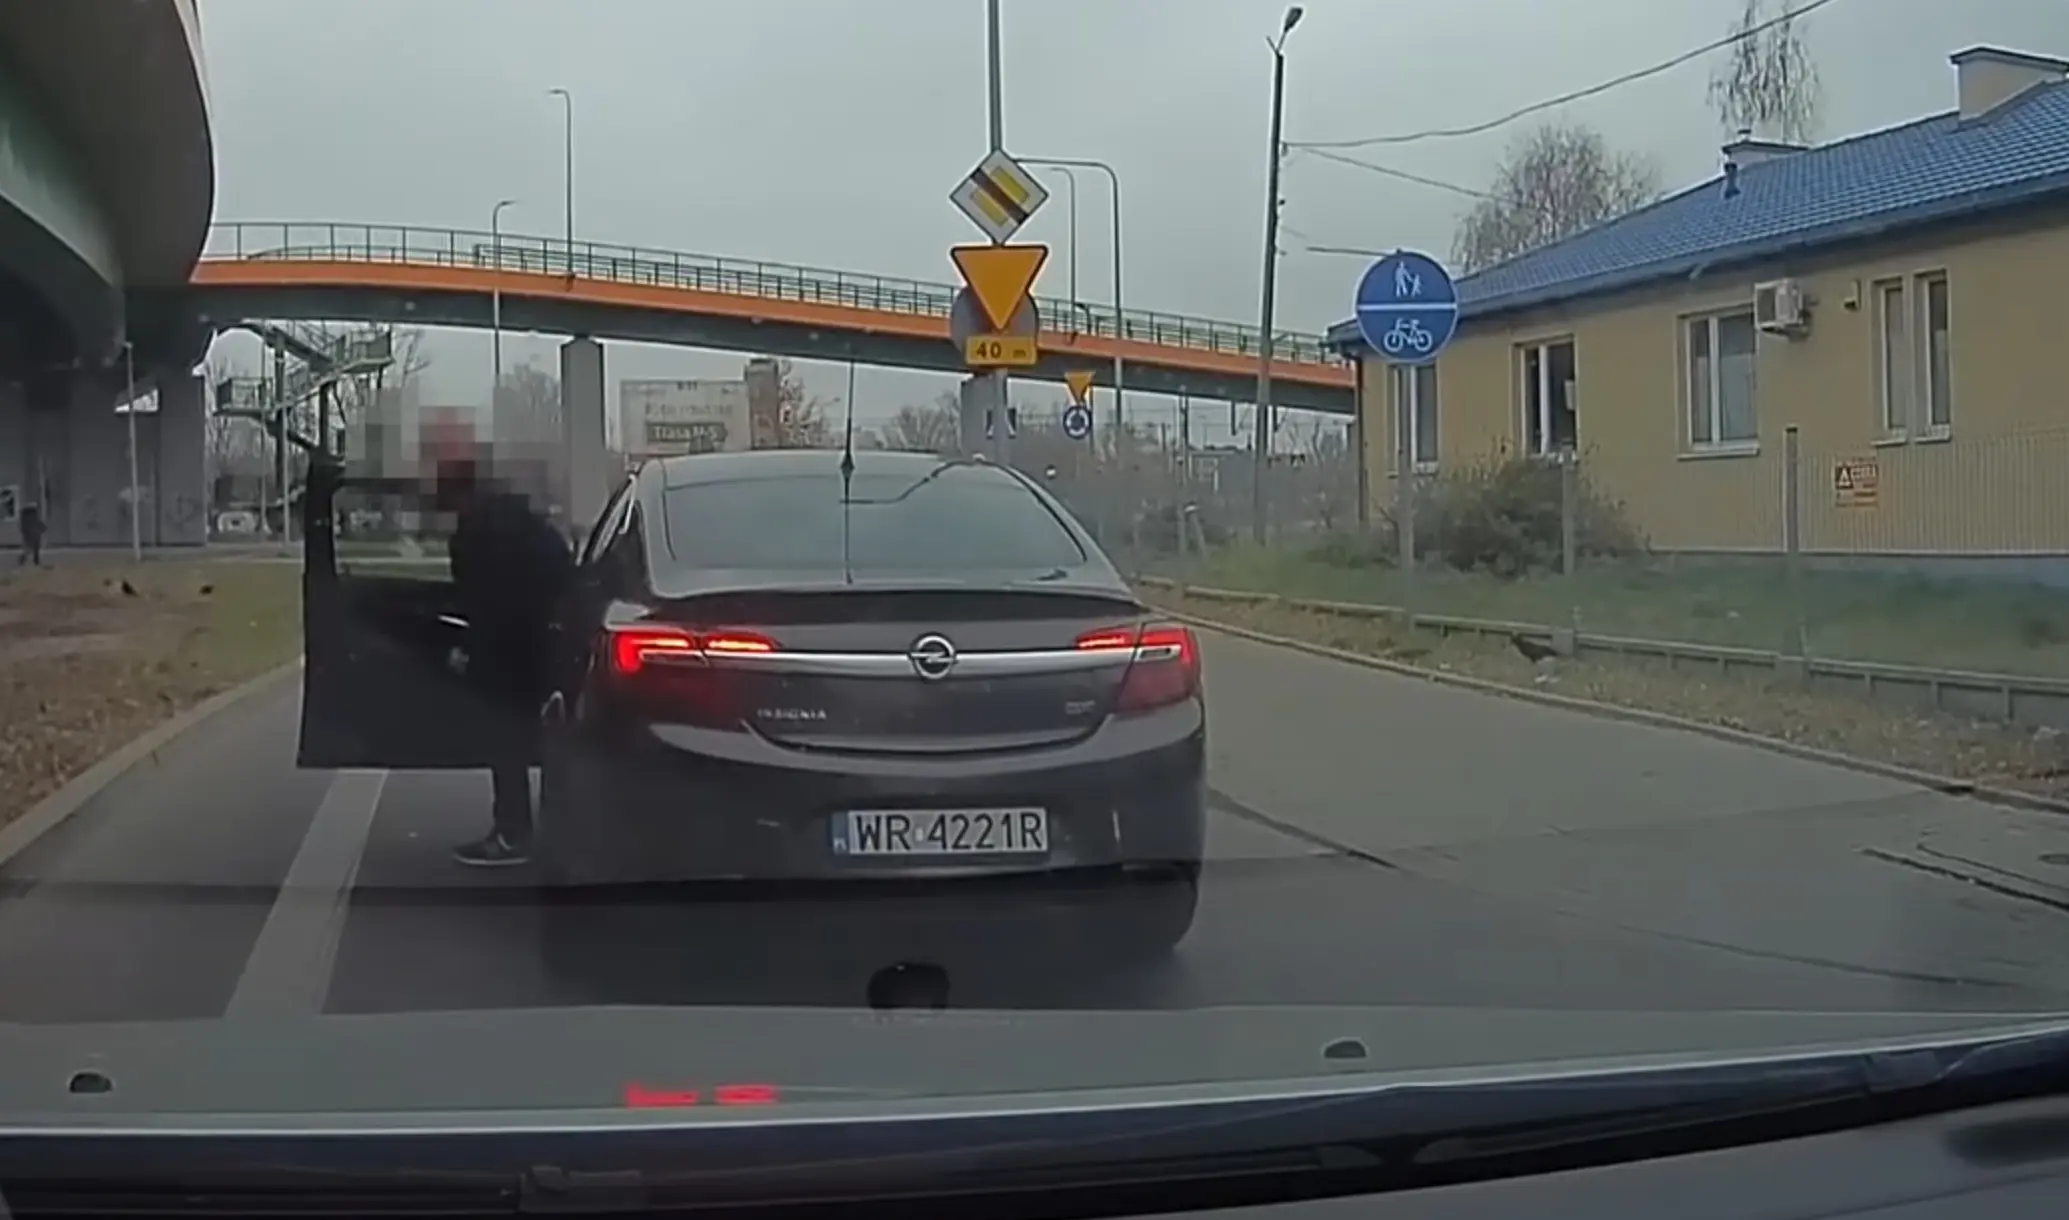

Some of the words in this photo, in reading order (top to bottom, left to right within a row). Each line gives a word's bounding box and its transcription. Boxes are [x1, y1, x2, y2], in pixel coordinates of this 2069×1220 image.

[976, 341, 1002, 359] 40
[757, 708, 826, 720] INSIGNIA
[856, 814, 911, 851] WR
[927, 812, 1042, 849] 4221R
